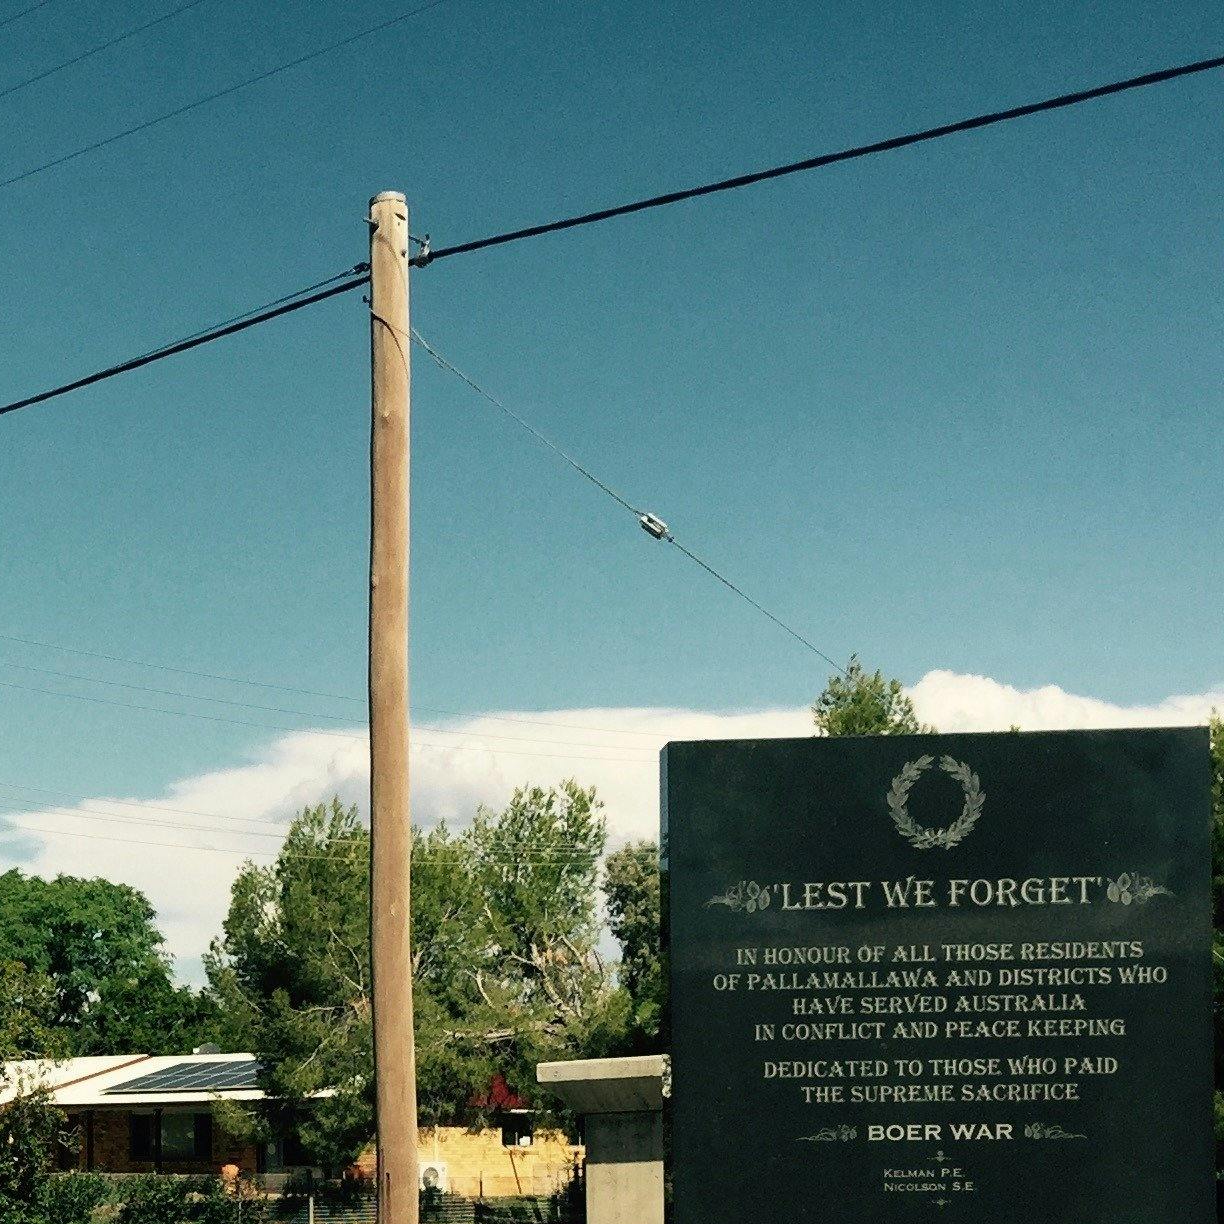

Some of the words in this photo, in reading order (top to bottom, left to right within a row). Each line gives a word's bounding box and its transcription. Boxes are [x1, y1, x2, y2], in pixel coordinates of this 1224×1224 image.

[881, 875, 936, 907] WE
[737, 948, 757, 965] IN
[763, 946, 851, 964] HONOUR
[857, 944, 885, 962] OF
[892, 945, 936, 962] ALL
[941, 944, 1014, 961] THOSE
[1020, 941, 1144, 961] RESIDENTS
[713, 974, 741, 991] OF
[747, 968, 939, 990] PALLAMALLAWA
[945, 970, 992, 987] AND
[999, 967, 1112, 986] DISTRICTS
[1118, 965, 1167, 984] WHO
[792, 995, 854, 1015] HAVE
[860, 994, 947, 1014] SERVED
[955, 994, 1087, 1012] AUSTRALIA
[755, 1024, 775, 1041] IN
[782, 1022, 885, 1040] CONFLICT
[892, 1022, 938, 1039] AND
[945, 1020, 1021, 1038] PEACE
[1028, 1019, 1126, 1037] KEEPING
[764, 1060, 888, 1078] DEDICATED
[895, 1059, 923, 1076] TO
[928, 1058, 1002, 1076] THOSE
[1007, 1055, 1057, 1075] WHO
[1064, 1057, 1118, 1074] PAID
[801, 1086, 845, 1103] THE
[851, 1085, 955, 1103] SUPREME
[961, 1083, 1080, 1102] SACRIFICE
[868, 1124, 942, 1141] BOER
[949, 1123, 1013, 1140] WAR
[884, 1169, 935, 1178] KELMAN
[884, 1183, 946, 1192] NICOLSON
